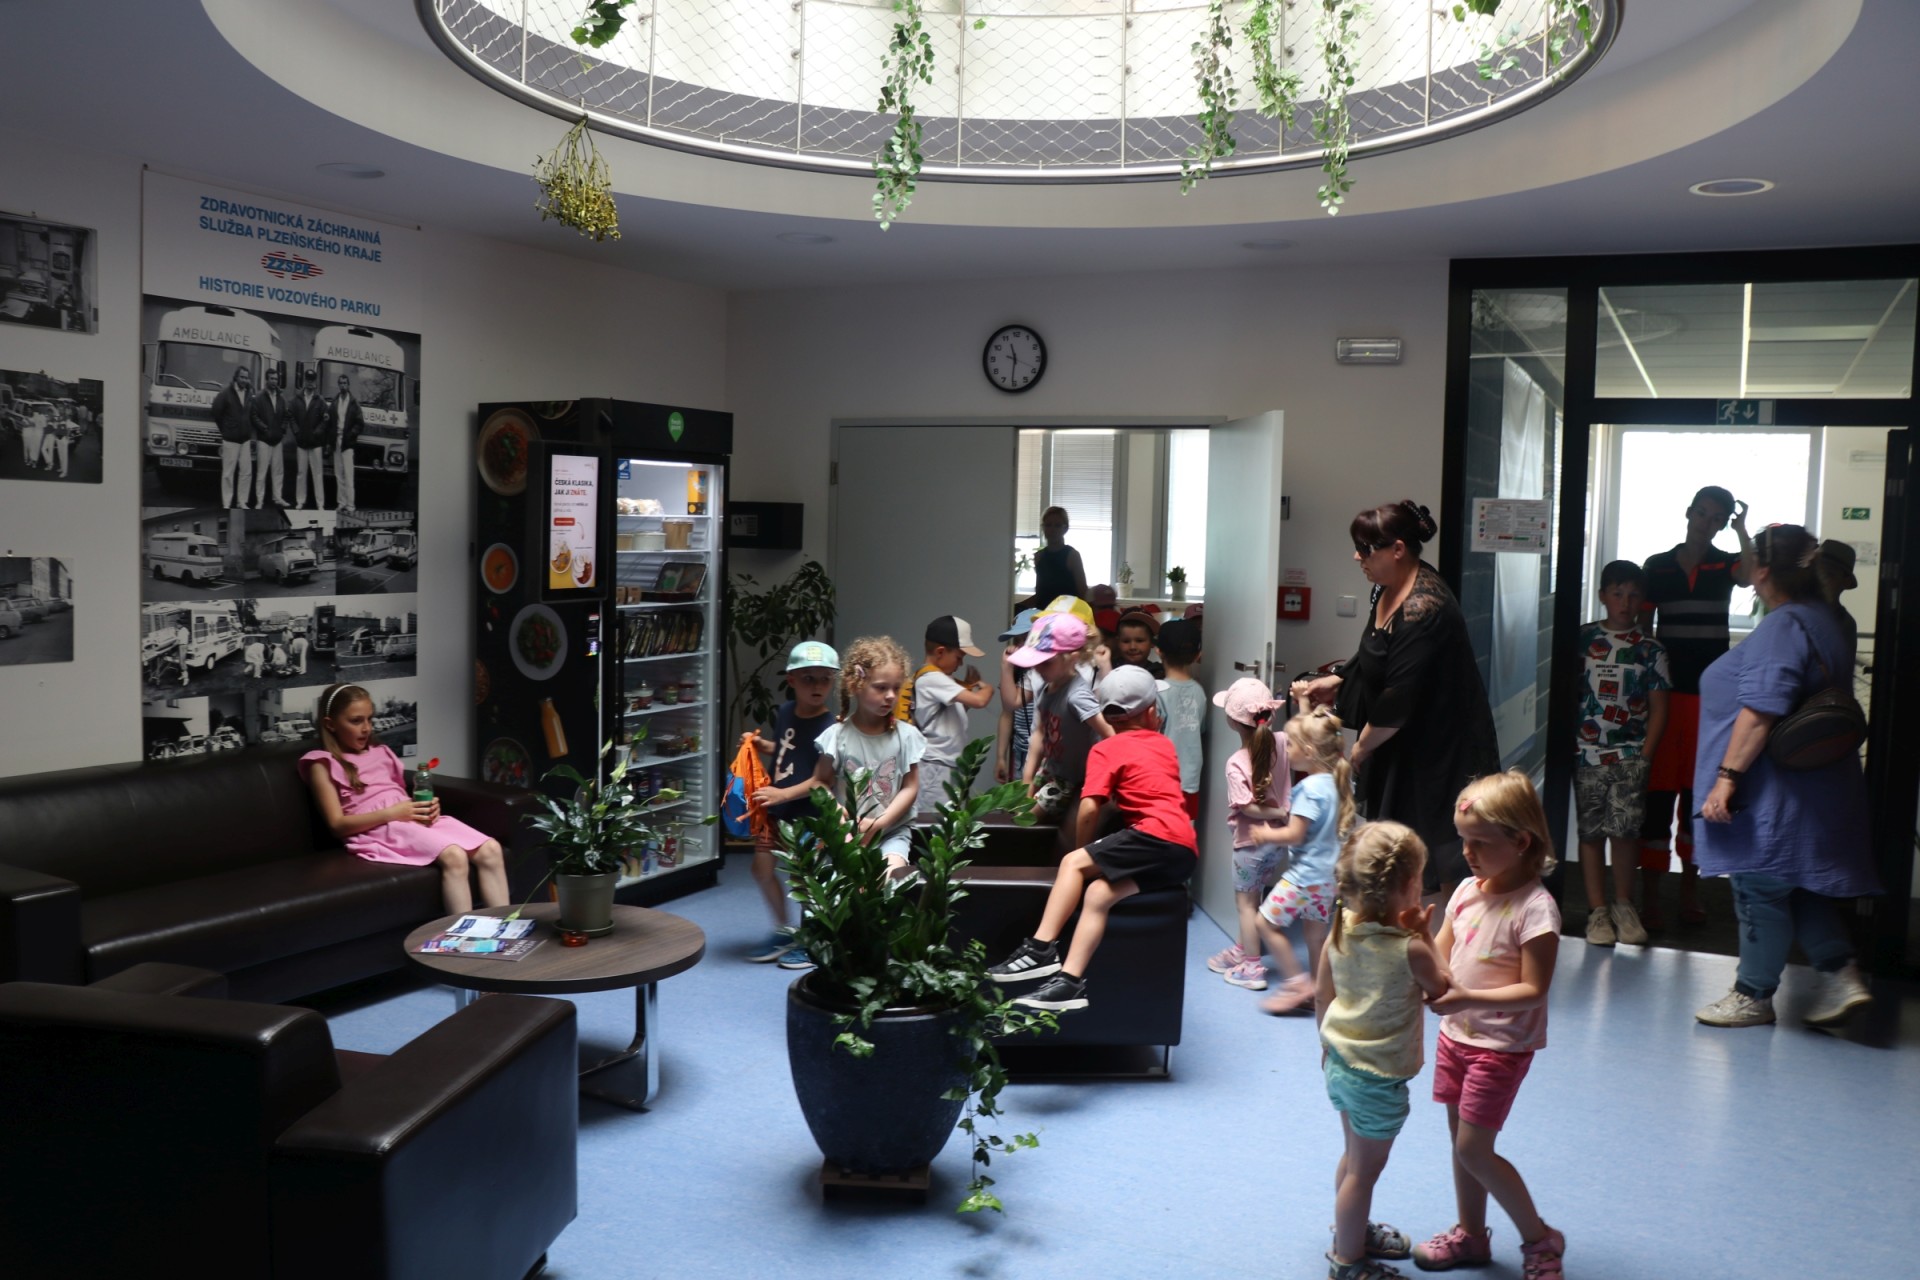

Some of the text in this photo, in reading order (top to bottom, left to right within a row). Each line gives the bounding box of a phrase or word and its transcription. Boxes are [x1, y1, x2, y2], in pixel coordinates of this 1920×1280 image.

[200, 196, 382, 245] ZDRAVOTNICKÁ ZÁCHRANNÁ
[199, 216, 382, 262] SLUŽBA PLZEŇSKÉHO KRAJE
[199, 276, 381, 317] HISTORIE VOZOVÉHO PARKU
[172, 327, 251, 346] AMBULANCE
[327, 346, 392, 367] AMBULANCE
[554, 477, 571, 486] ČESKÁ
